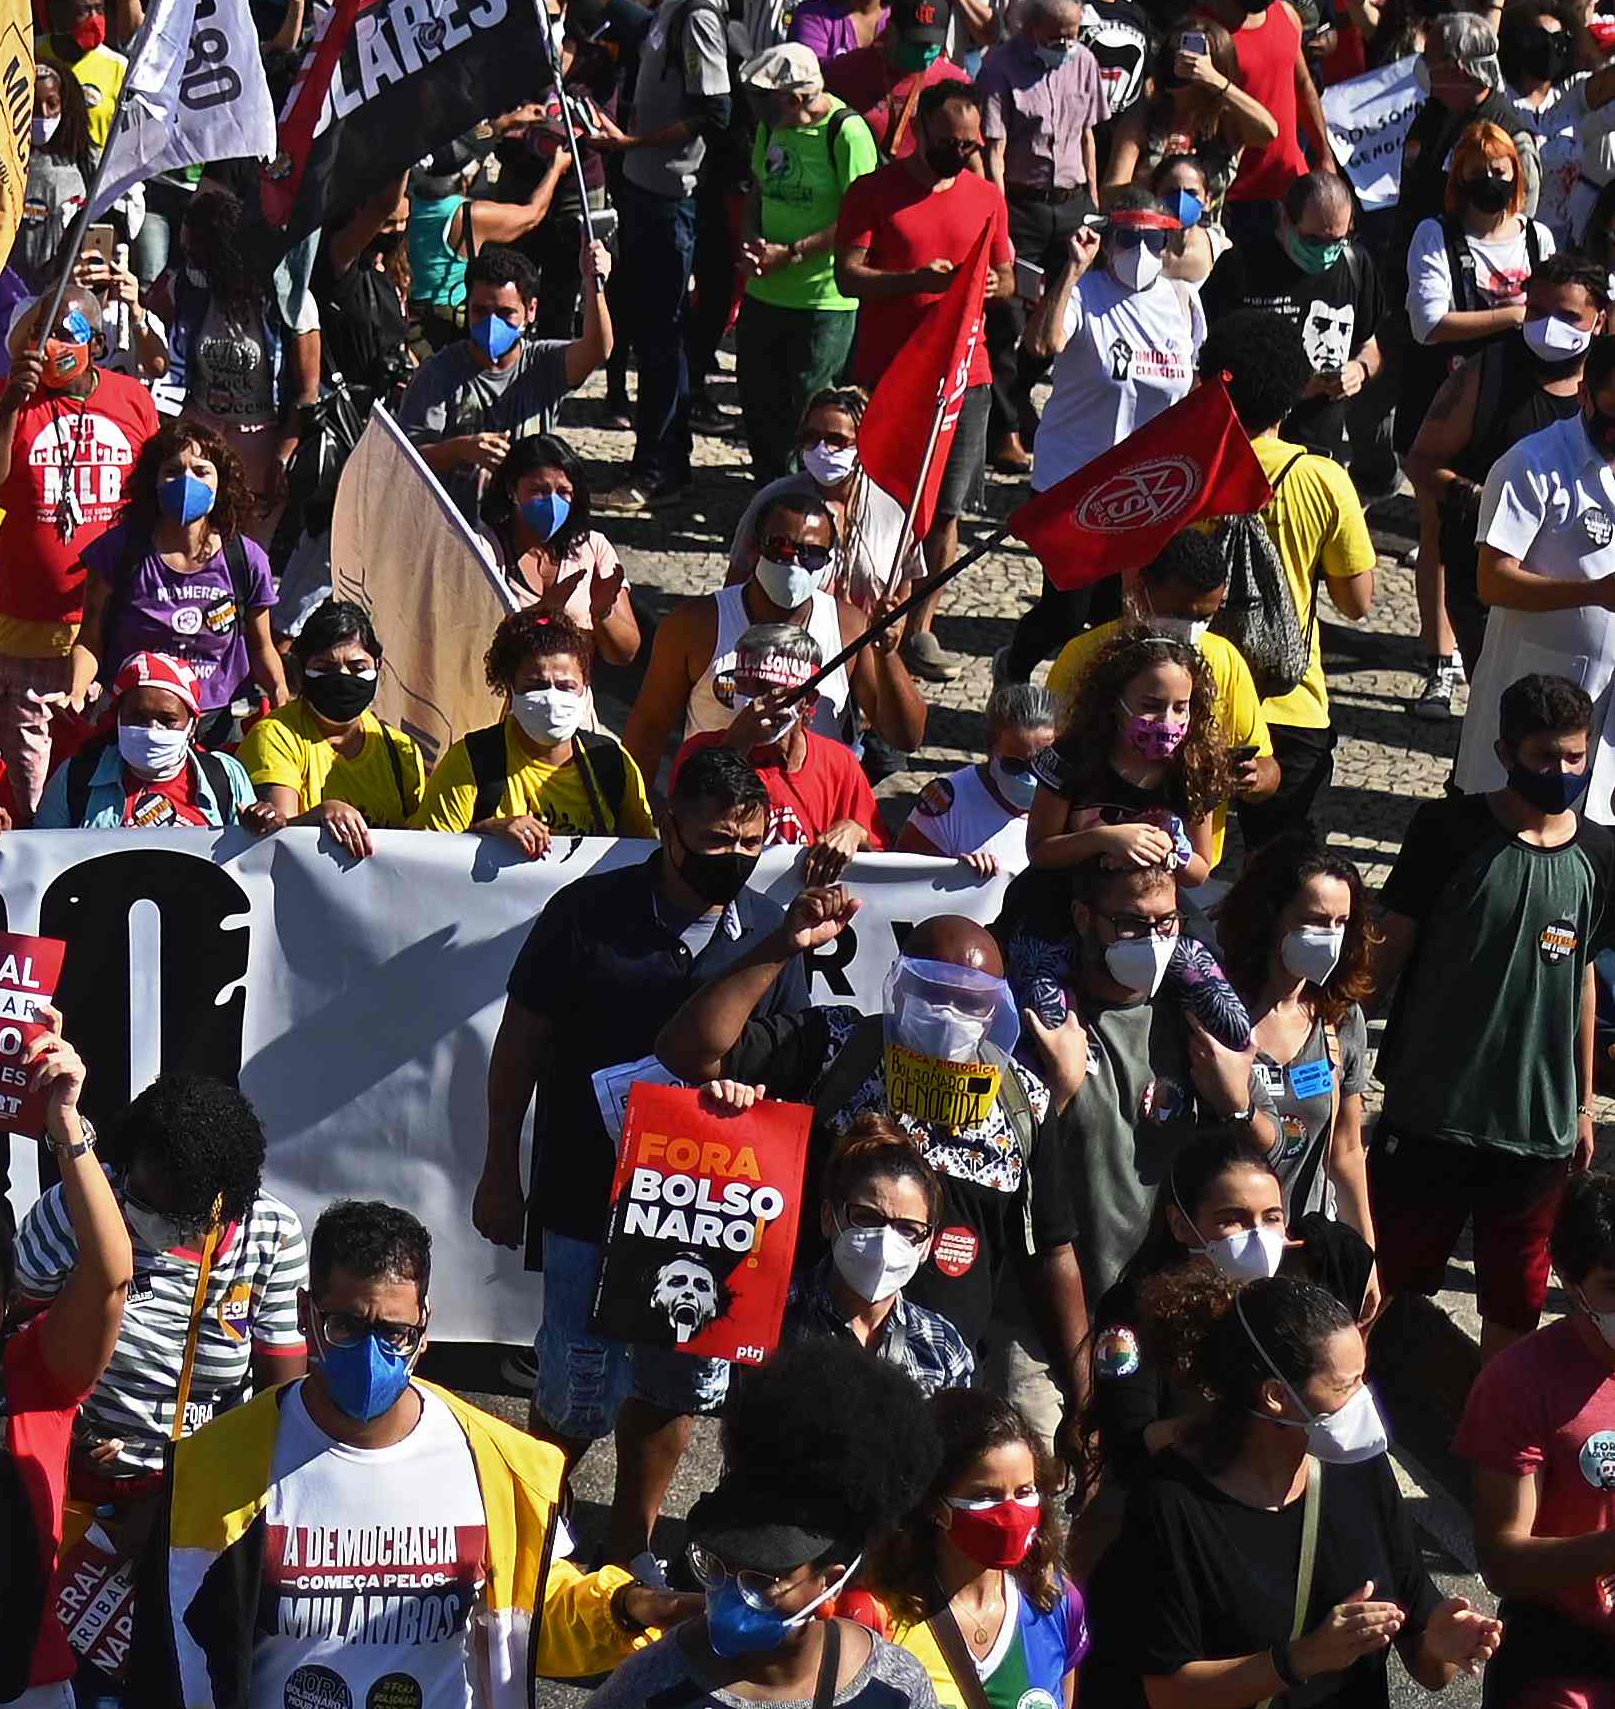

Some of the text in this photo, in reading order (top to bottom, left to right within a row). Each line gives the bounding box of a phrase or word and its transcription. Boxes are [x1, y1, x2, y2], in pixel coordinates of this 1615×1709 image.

[43, 465, 122, 505] MLB
[891, 1052, 966, 1093] BOLSONARO
[890, 1078, 985, 1130] GENOCIDA
[636, 1132, 764, 1182] FORA
[629, 1167, 785, 1221] BOLSO
[622, 1202, 767, 1269] NARO!
[735, 1345, 765, 1363] ptrj
[181, 1402, 215, 1428] FORA
[281, 1524, 459, 1570] A DEMOCRACIA
[295, 1572, 448, 1596] COMEÇA PELOS
[276, 1595, 462, 1648] MULAMBOS
